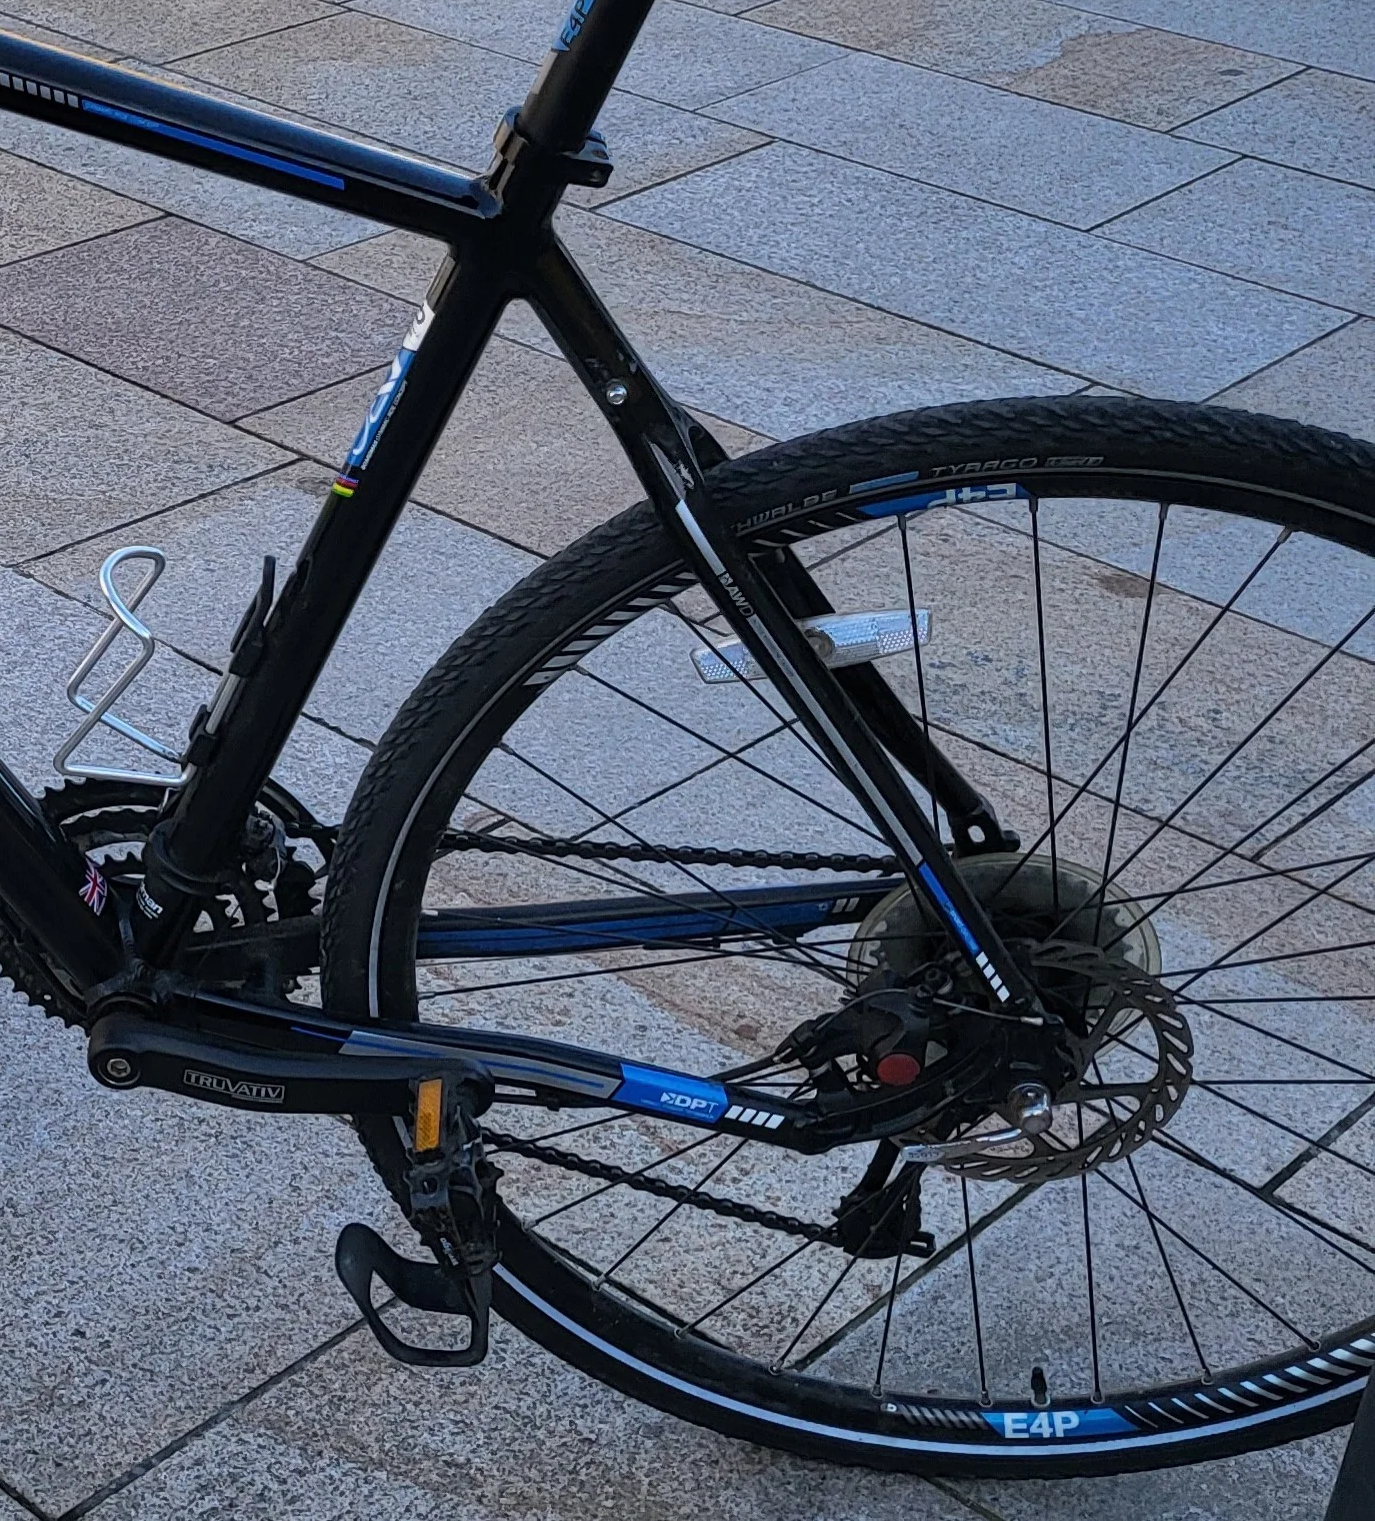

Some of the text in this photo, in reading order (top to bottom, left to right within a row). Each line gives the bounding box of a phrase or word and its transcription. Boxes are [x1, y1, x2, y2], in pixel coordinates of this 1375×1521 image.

[730, 489, 838, 531] HWALBE
[187, 1071, 282, 1099] TRUVATIV
[1003, 1410, 1081, 1439] E4P
